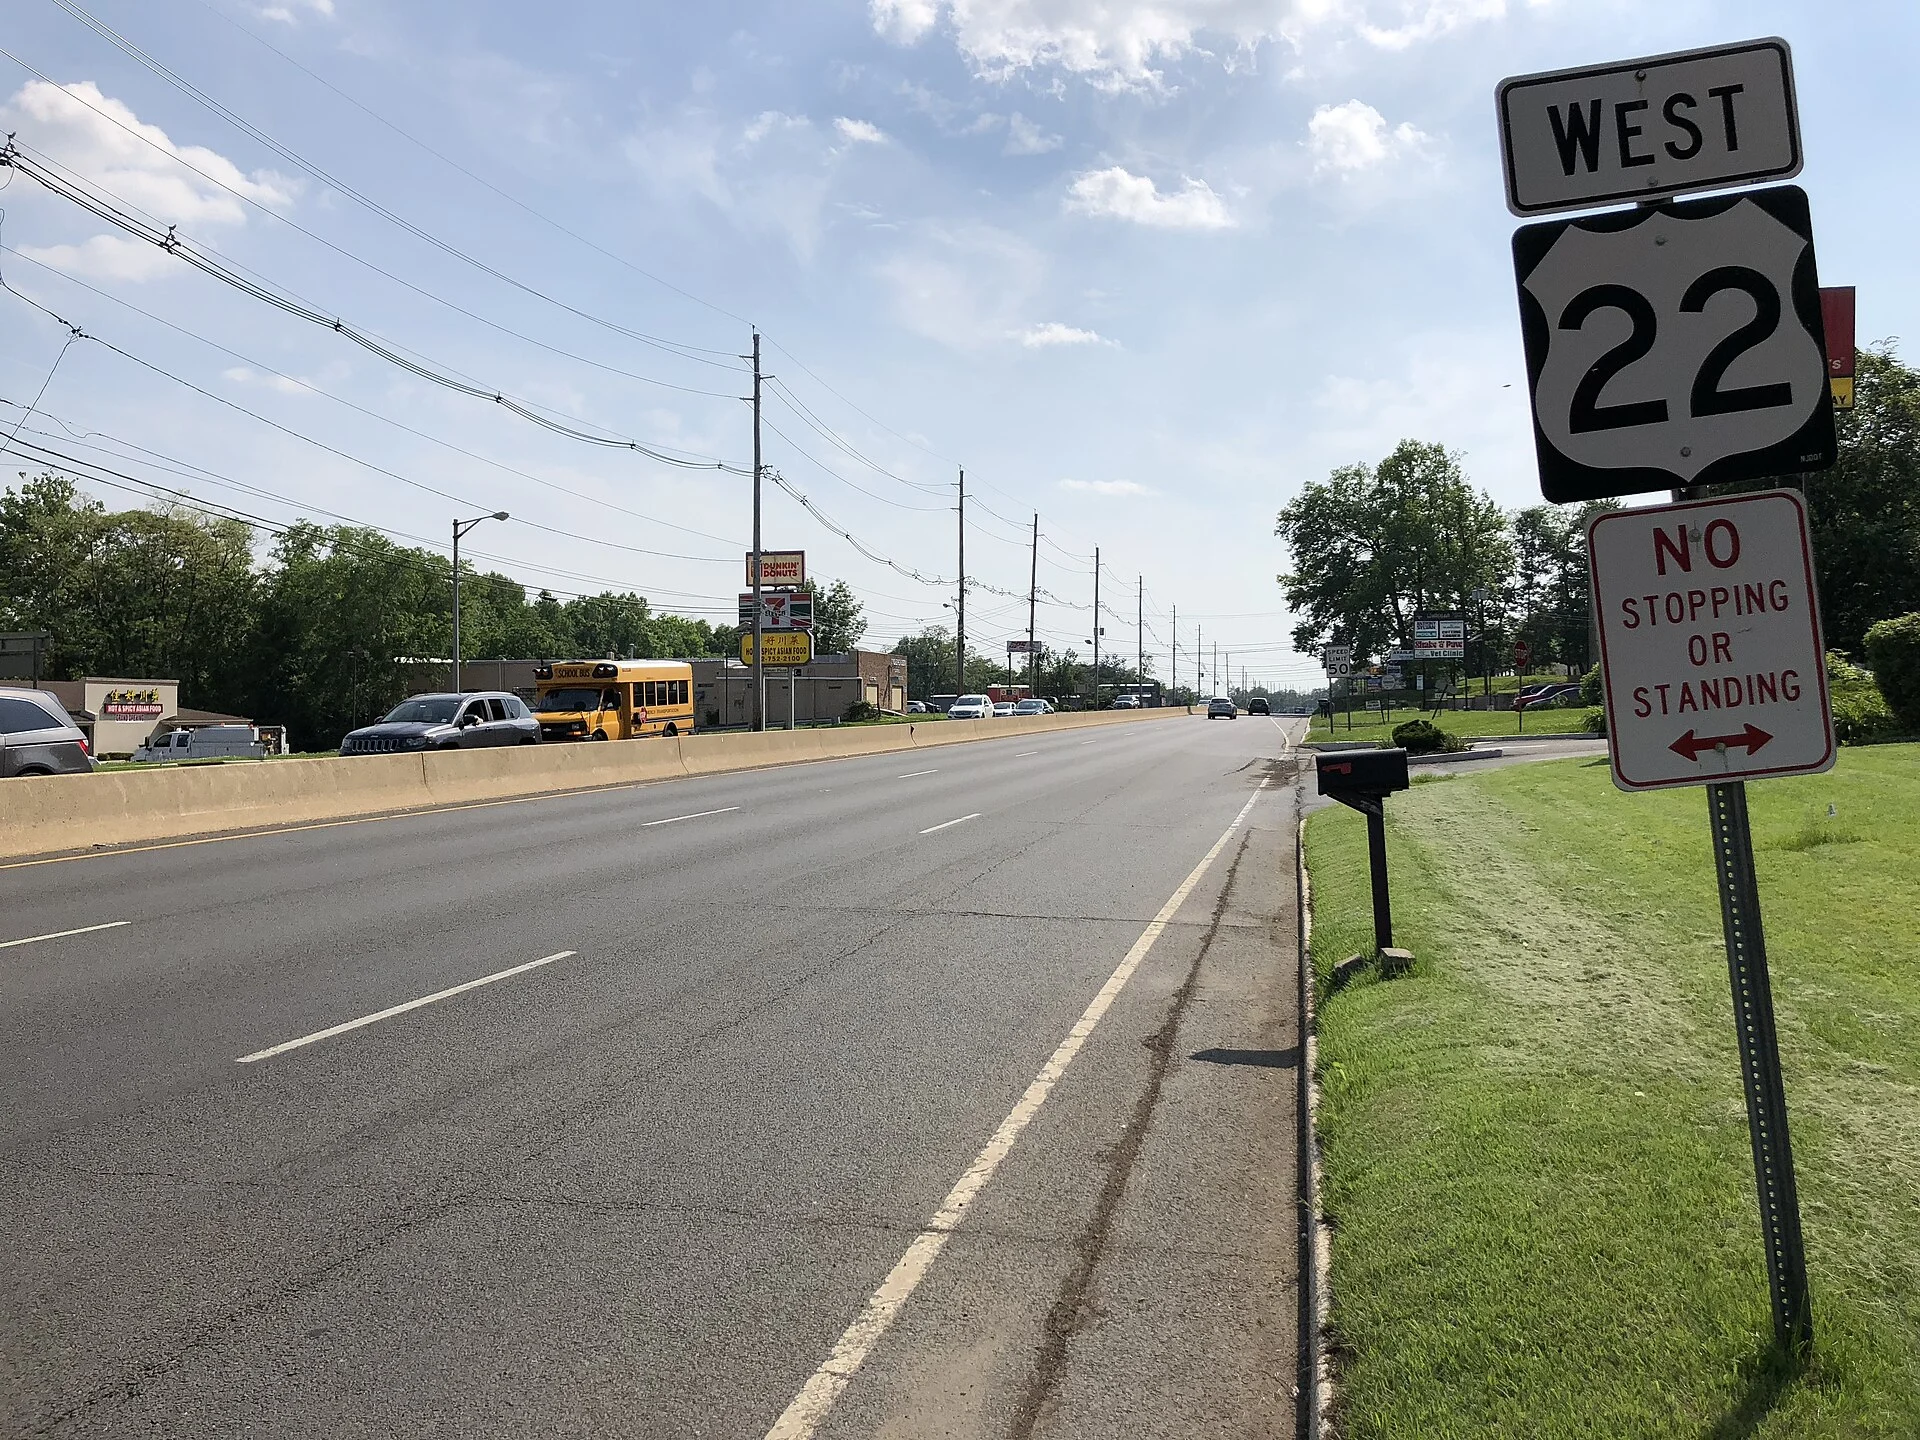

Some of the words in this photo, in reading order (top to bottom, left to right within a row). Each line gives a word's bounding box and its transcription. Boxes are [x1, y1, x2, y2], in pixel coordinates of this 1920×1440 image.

[1547, 84, 1744, 176] WEST
[1558, 266, 1793, 434] 22
[1653, 518, 1741, 576] NO
[764, 561, 800, 570] DUNKIN'
[764, 569, 798, 578] DONUTS
[1622, 579, 1789, 629] STOPPING
[764, 635, 800, 646] 好川菜
[761, 647, 777, 656] SPICY
[777, 647, 793, 655] ASIAN
[793, 646, 807, 655] FOOD
[1688, 632, 1732, 666] OR
[558, 668, 579, 678] SCHOOL
[579, 668, 590, 678] BUS
[1328, 663, 1349, 675] 50
[1633, 669, 1801, 718] STANDING
[136, 704, 150, 712] ASIAN
[150, 704, 162, 712] FOOD
